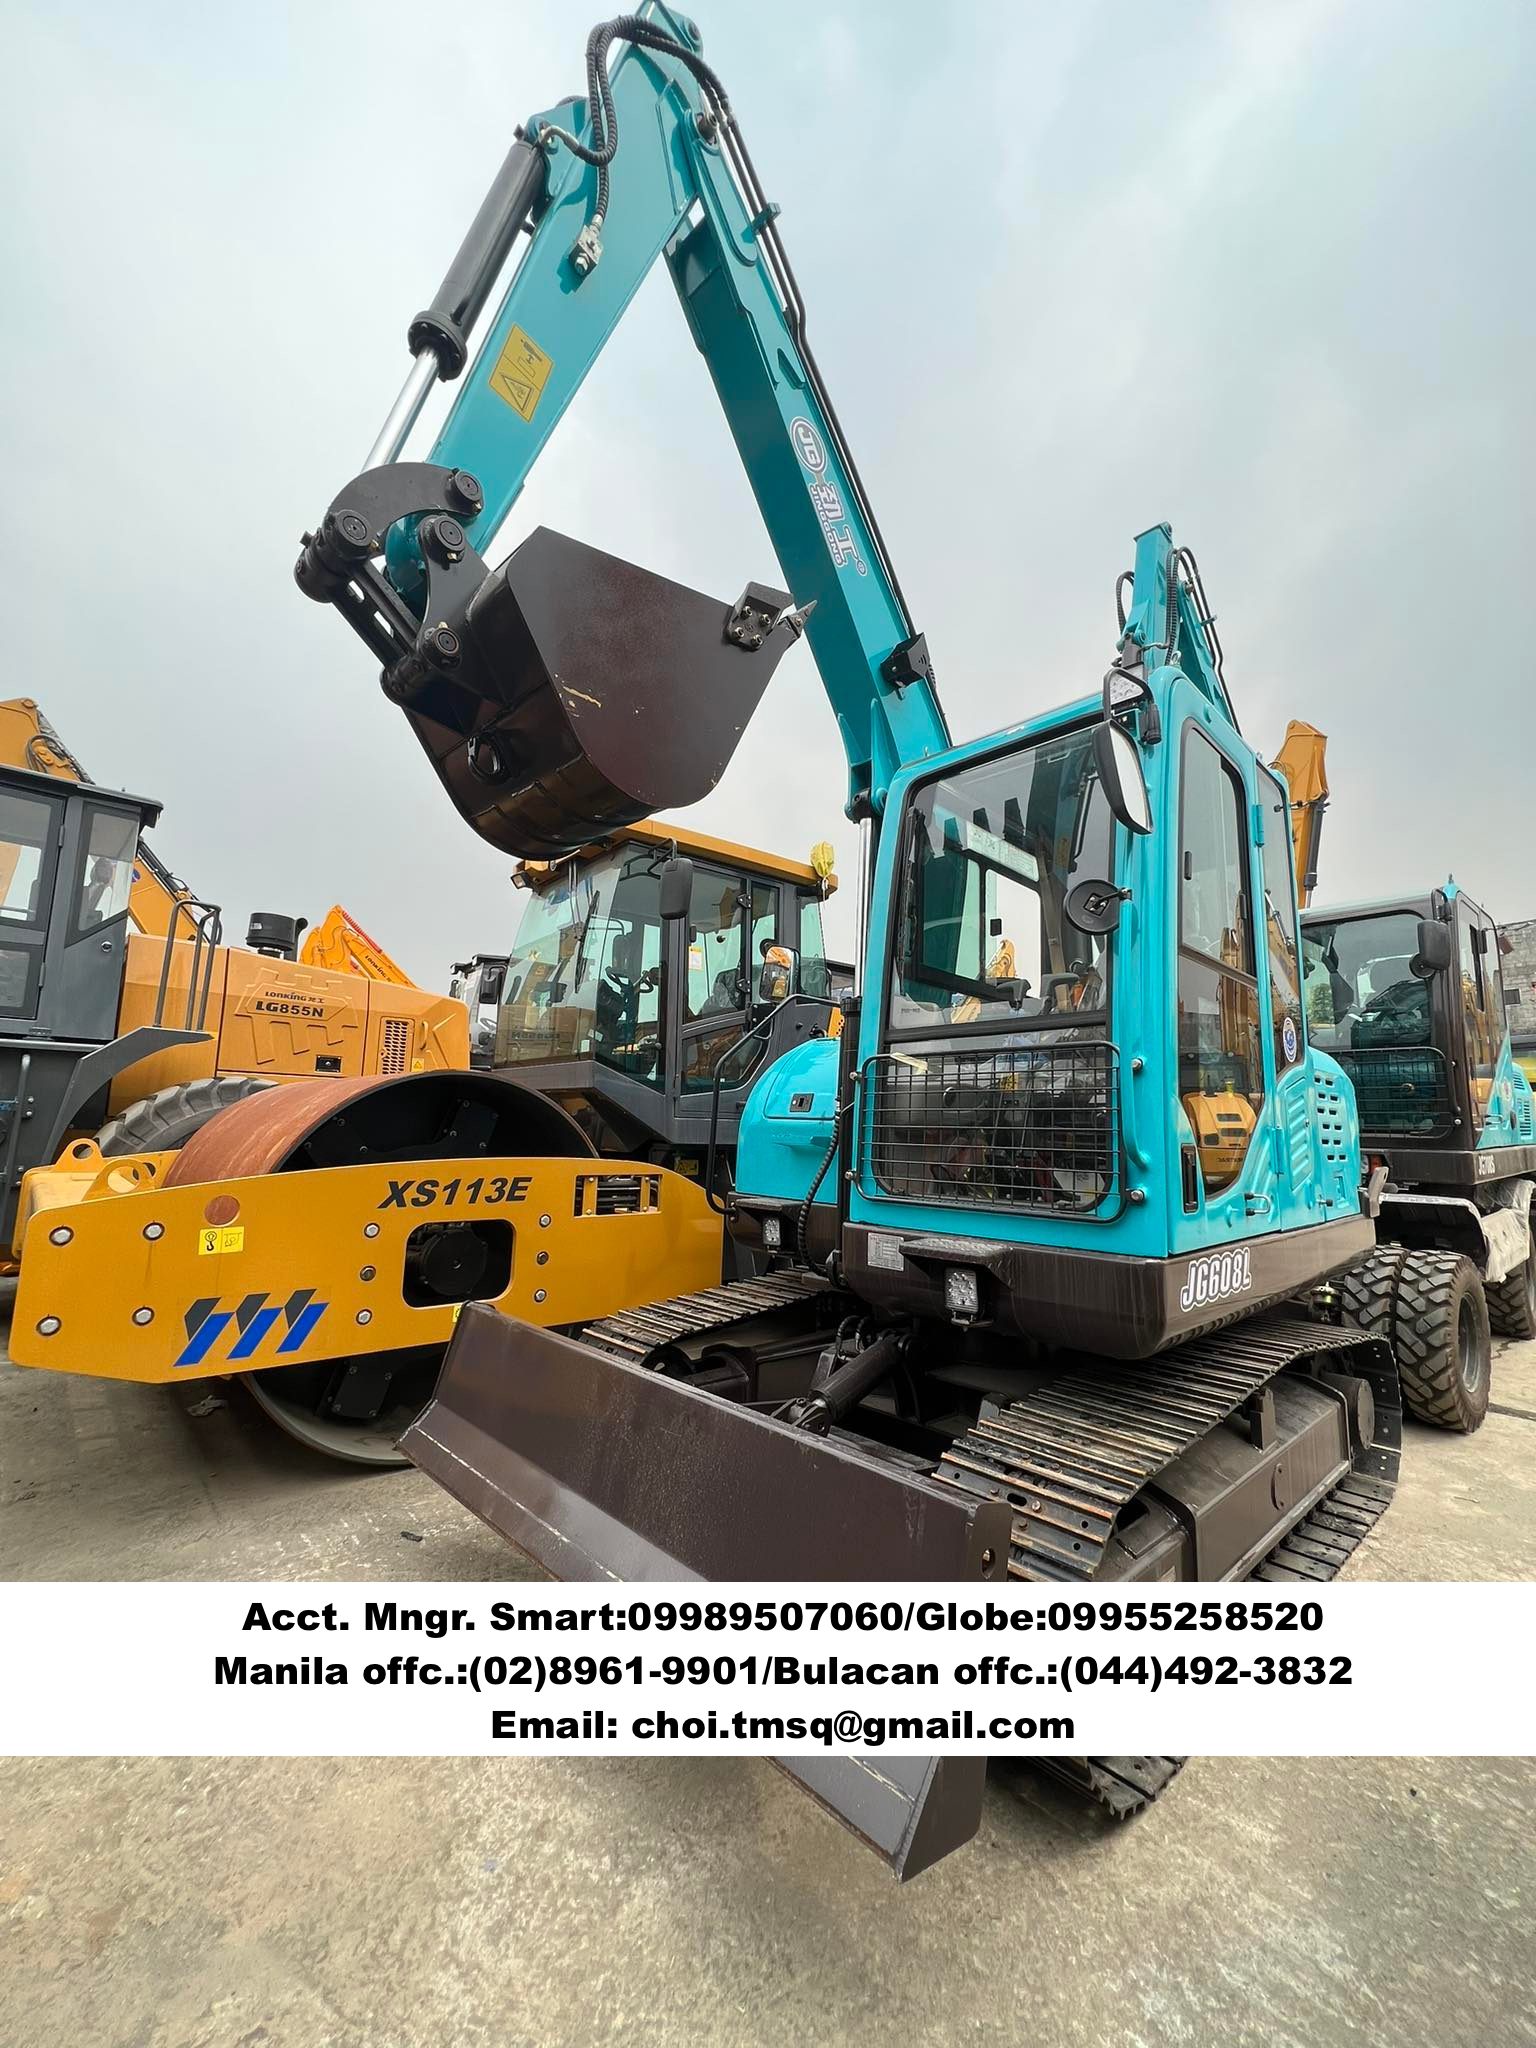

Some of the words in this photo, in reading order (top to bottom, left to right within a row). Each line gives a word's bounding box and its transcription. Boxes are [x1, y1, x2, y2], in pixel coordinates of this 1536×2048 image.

[255, 1000, 324, 1018] LG855N
[377, 1177, 533, 1209] XS113E
[1181, 1249, 1251, 1309] JG608L
